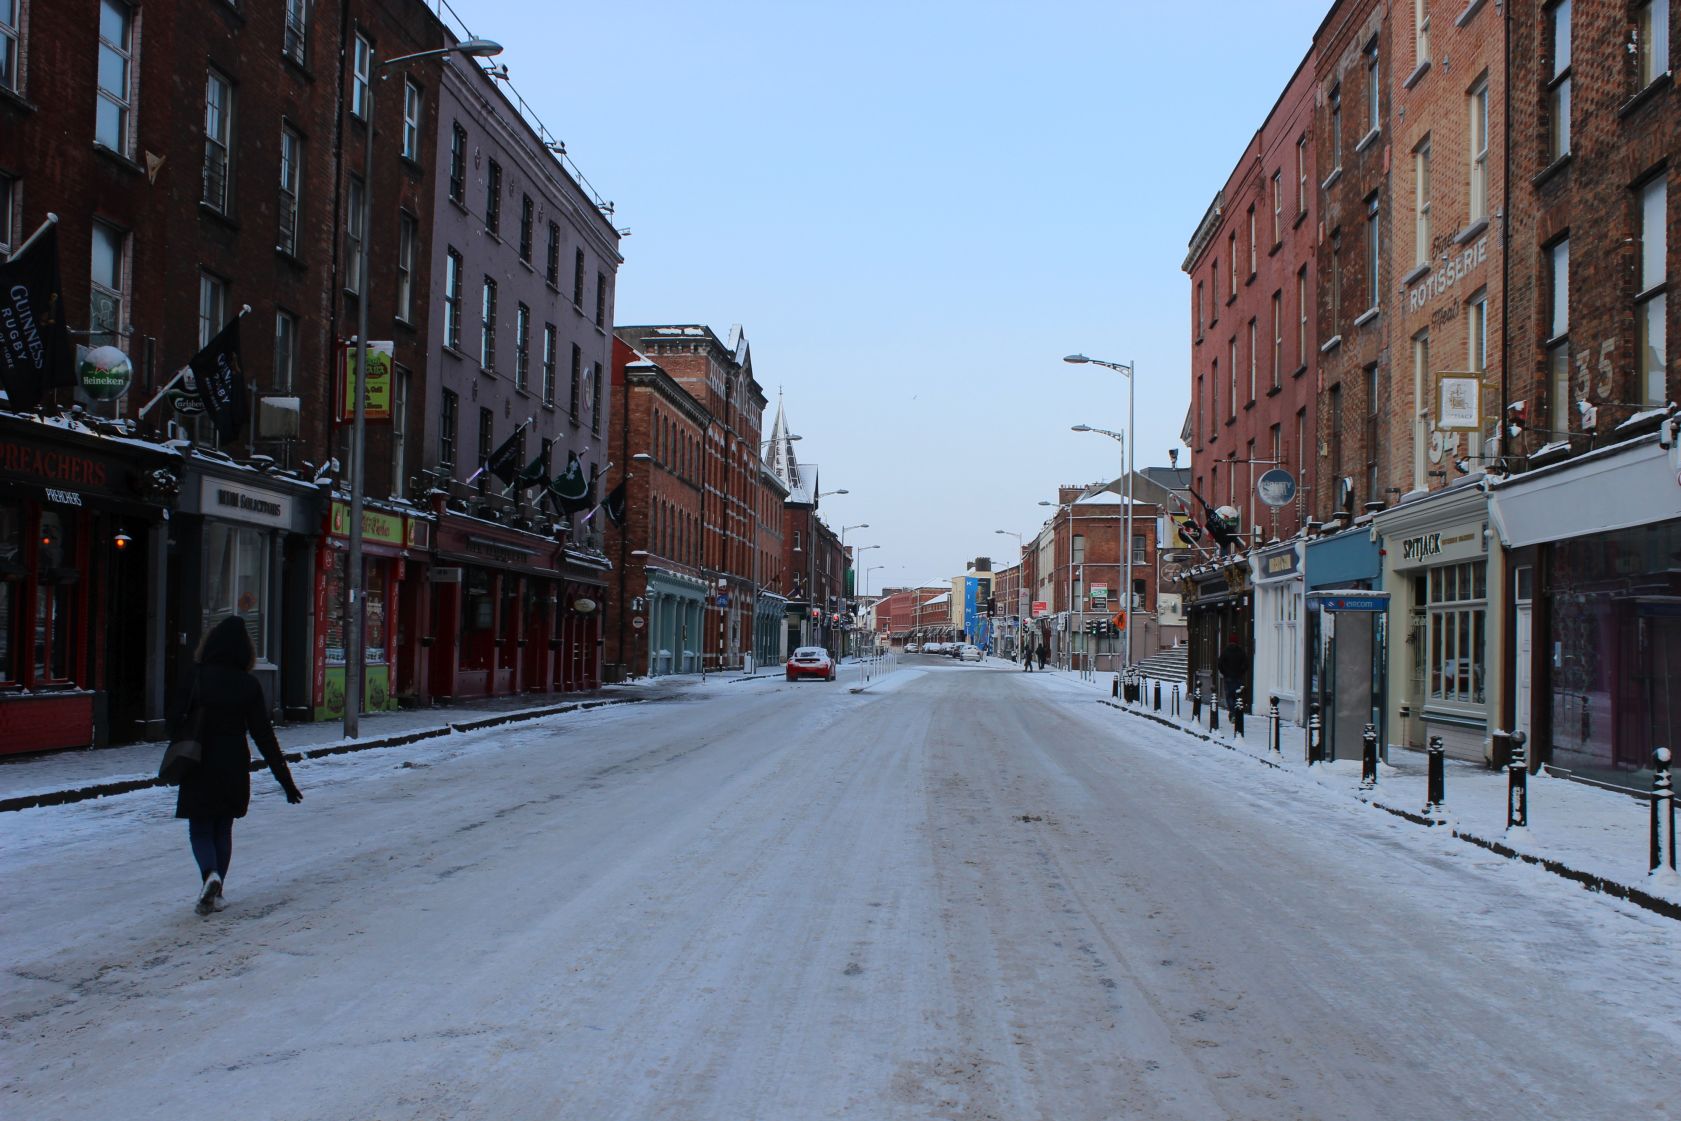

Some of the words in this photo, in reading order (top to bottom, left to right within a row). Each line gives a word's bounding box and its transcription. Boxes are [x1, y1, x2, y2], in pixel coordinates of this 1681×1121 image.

[1410, 236, 1488, 313] ROTISSERIE
[2, 307, 28, 359] RUGBY
[10, 285, 44, 369] GUINNESS
[83, 376, 124, 385] Heineken
[1574, 336, 1616, 402] 35
[173, 397, 206, 410] Carlsber
[45, 487, 82, 507] PREACHERS
[1403, 532, 1440, 562] SPITJACK
